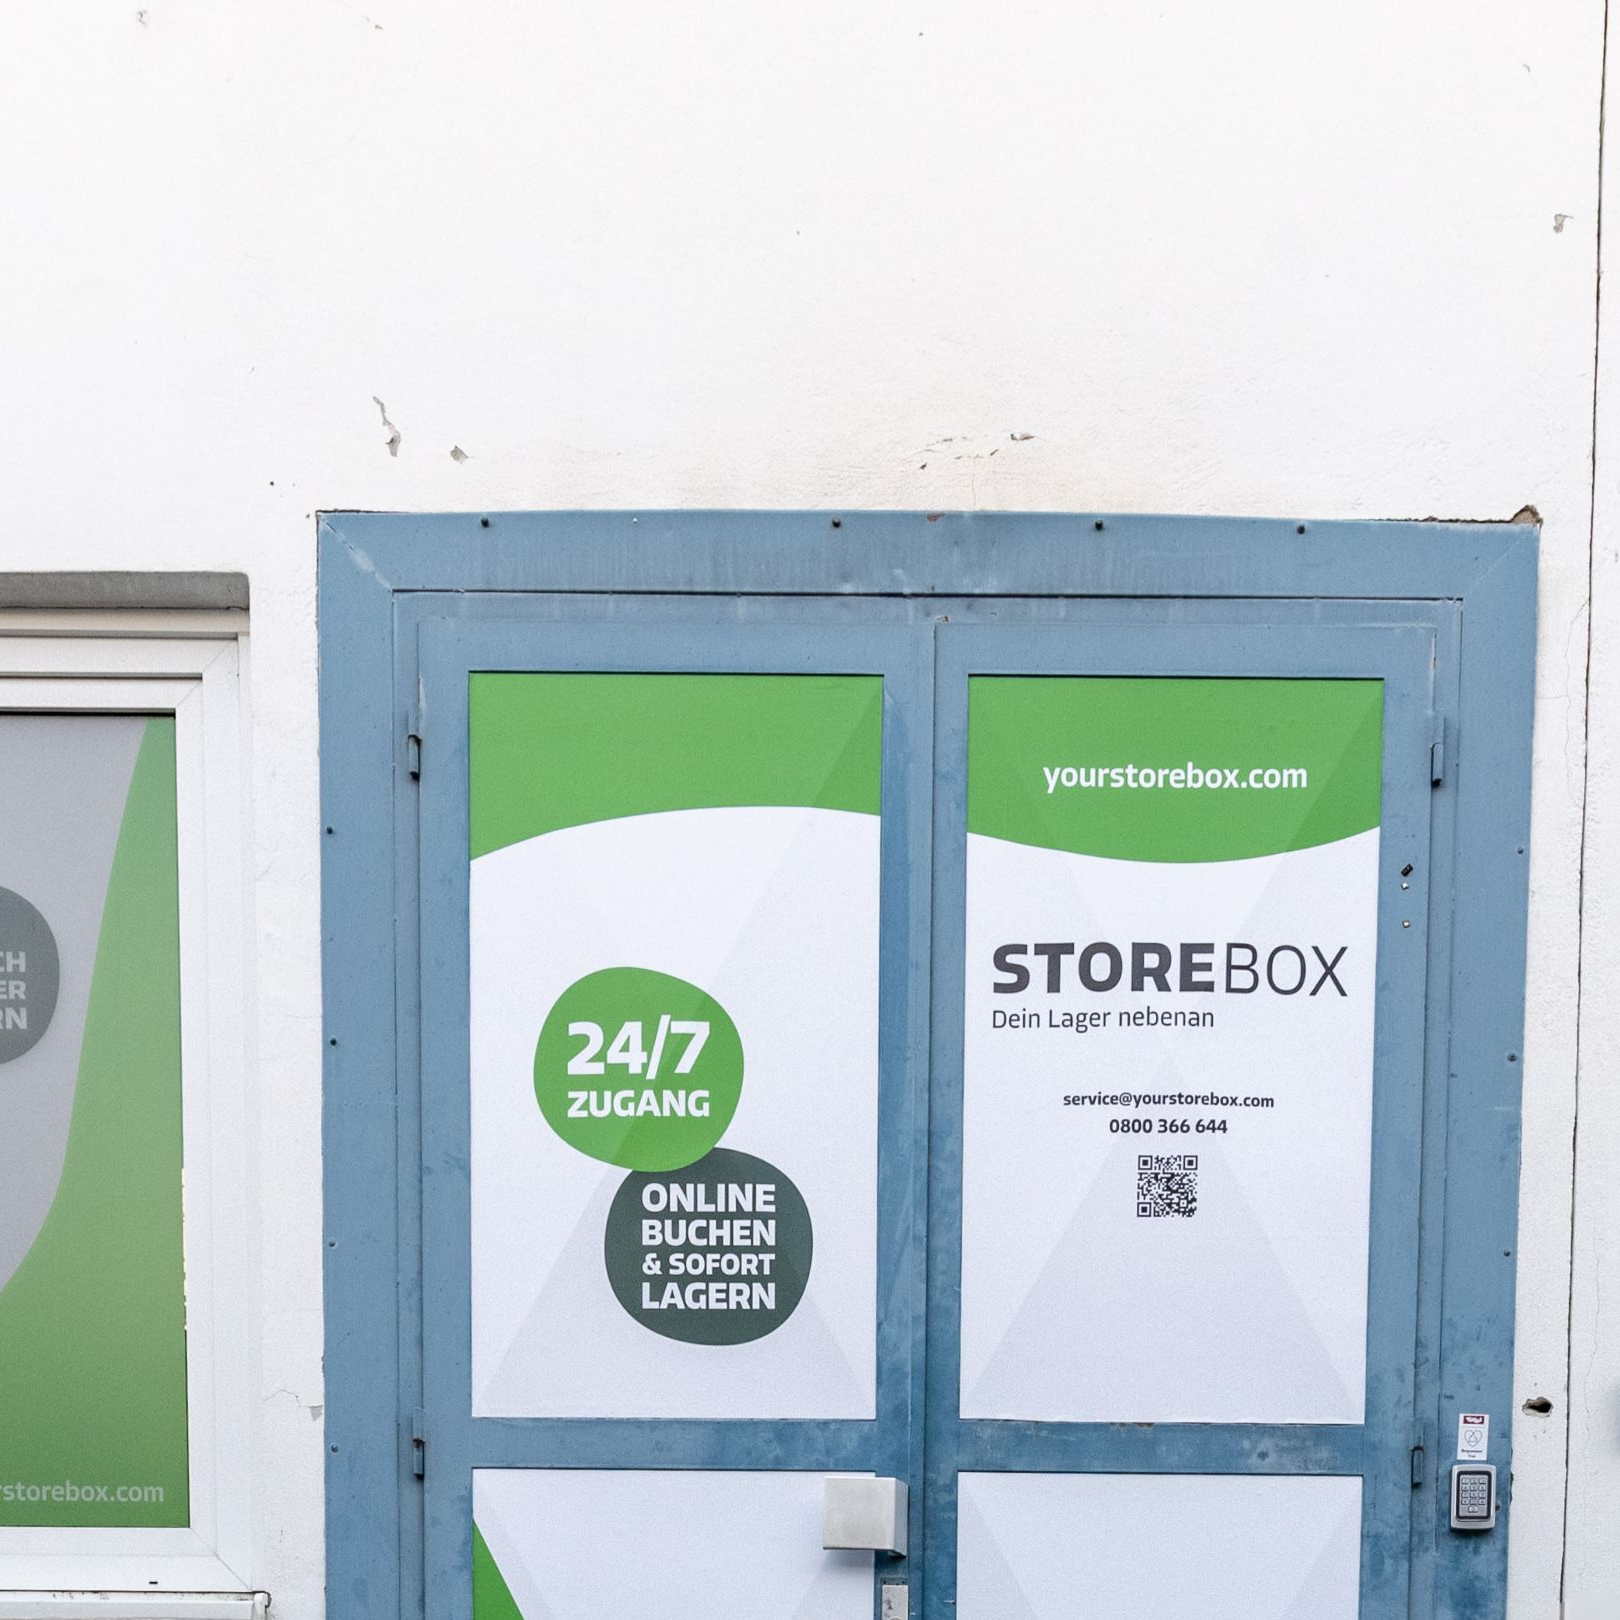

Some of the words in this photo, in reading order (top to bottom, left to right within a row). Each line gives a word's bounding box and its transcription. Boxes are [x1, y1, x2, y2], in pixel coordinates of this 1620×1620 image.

[1043, 761, 1308, 794] yourstorebox.com
[993, 941, 1348, 997] STOREBOX
[992, 1009, 1040, 1029] Dein
[1048, 1009, 1112, 1034] Lager
[1118, 1005, 1214, 1028] nebenan
[567, 1014, 710, 1080] 24/7
[567, 1089, 710, 1118] ZUGANG
[1063, 1091, 1275, 1109] service@yourstorebox.com
[1109, 1118, 1153, 1134] 0800
[1157, 1118, 1191, 1134] 366
[1195, 1118, 1228, 1134] 644
[641, 1182, 776, 1213] ONLINE
[641, 1219, 776, 1247] BUCHEN
[642, 1252, 663, 1275] &
[668, 1252, 776, 1276] SOFORT
[641, 1281, 776, 1310] LAGERN
